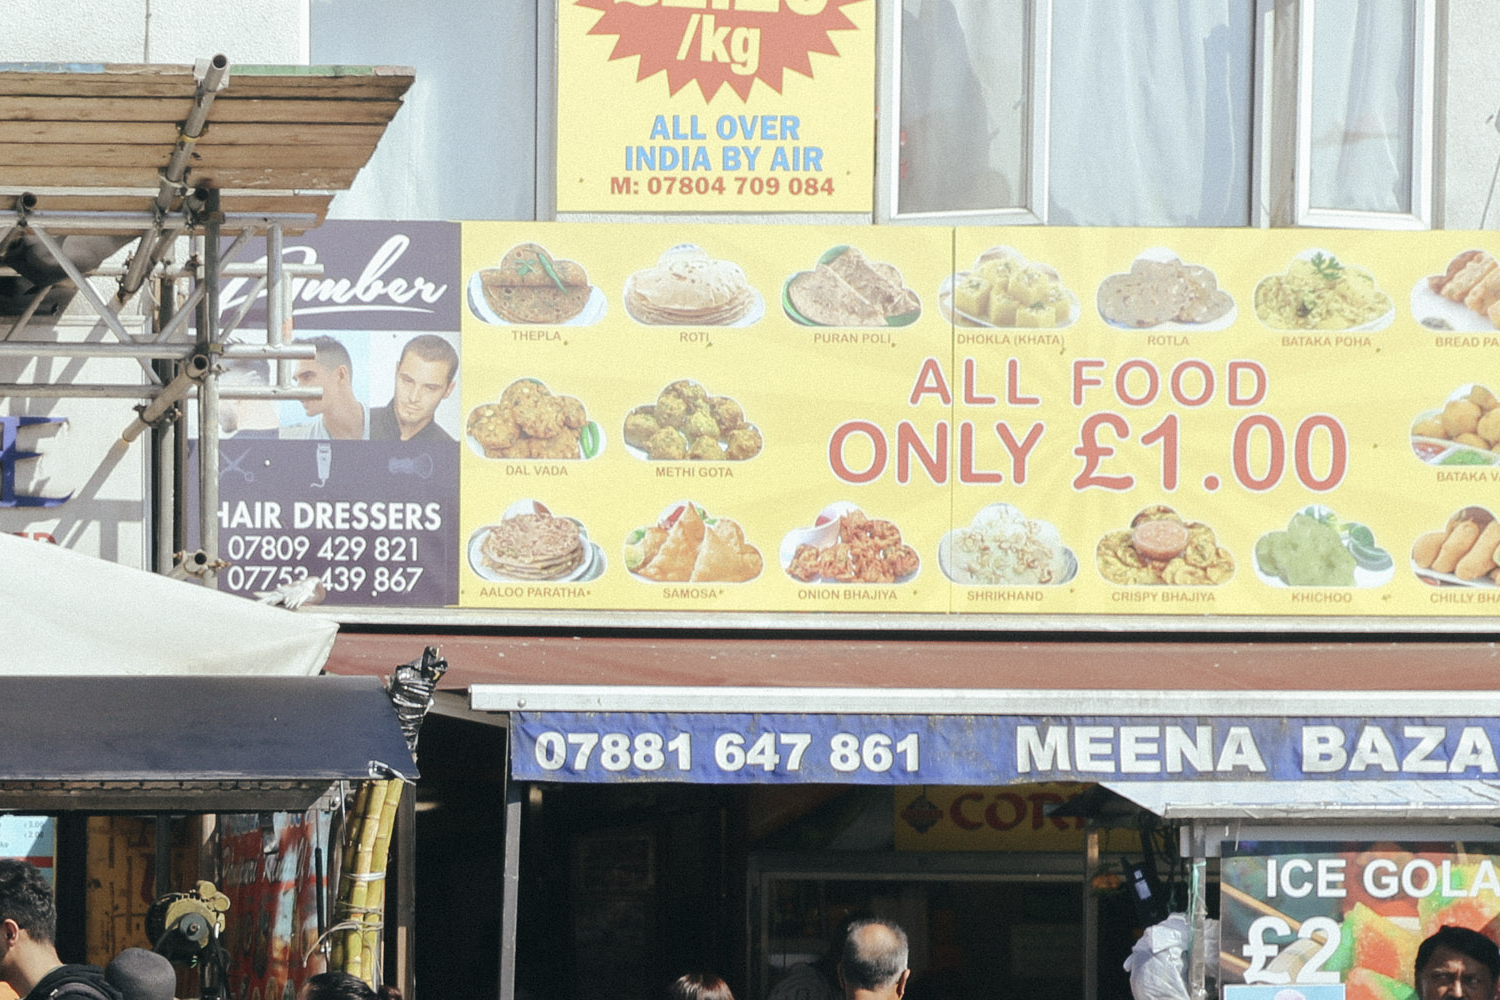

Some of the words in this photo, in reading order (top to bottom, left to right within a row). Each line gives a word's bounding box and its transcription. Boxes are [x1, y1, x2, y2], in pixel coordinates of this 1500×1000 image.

[675, 13, 761, 76] /kg
[650, 115, 706, 140] ALL
[716, 115, 800, 140] OVER
[625, 146, 712, 171] INDIA
[722, 146, 761, 171] BY
[770, 147, 824, 171] AIR
[610, 177, 639, 195] M:
[647, 177, 726, 195] 07804
[734, 177, 780, 195] 709
[789, 177, 835, 195] 084
[511, 330, 562, 341] THEPLA
[679, 331, 710, 342] ROTI
[813, 332, 859, 344] PURAN
[862, 333, 891, 344] POLI
[956, 334, 1011, 345] DHOKLA
[1014, 334, 1065, 347] (KHATA)
[1147, 335, 1190, 346] ROTLA
[1281, 336, 1333, 347] BATAKA
[1336, 336, 1372, 347] POHA
[1435, 336, 1480, 347] BREAD
[910, 357, 1041, 406] ALL
[1073, 360, 1267, 406] FOOD
[829, 421, 1044, 484] ONLY
[1074, 412, 1347, 491] £1.00
[505, 465, 530, 476] DAL
[534, 465, 568, 476] VADA
[655, 467, 695, 478] METHI
[698, 467, 734, 478] GOTA
[1437, 472, 1487, 482] BATAKA
[1489, 473, 1500, 482] V
[294, 501, 442, 531] DRESSERS
[228, 535, 310, 561] 07809
[317, 536, 367, 561] 429
[374, 537, 418, 562] 821
[320, 567, 366, 592] 439
[373, 567, 424, 592] 867
[479, 587, 524, 598] AALOO
[526, 587, 585, 598] PARATHA
[662, 588, 718, 600] SAMOSA
[797, 589, 842, 601] ONION
[843, 589, 898, 601] BHAJIYA
[966, 590, 1044, 602] SHRIKHAND
[1111, 591, 1158, 603] CRISPY
[1161, 591, 1216, 603] BHAJIYA
[1291, 592, 1353, 604] KHICHOO
[1430, 593, 1475, 604] CHILLY
[535, 731, 692, 771] 07881
[714, 732, 812, 772] 647
[829, 732, 920, 773] 861
[1016, 725, 1268, 774] MEENA
[1301, 726, 1500, 774] BAZA
[950, 792, 1086, 831] COR
[1266, 858, 1347, 898] ICE
[1362, 858, 1500, 899] GOLA
[1242, 915, 1342, 985] £2
